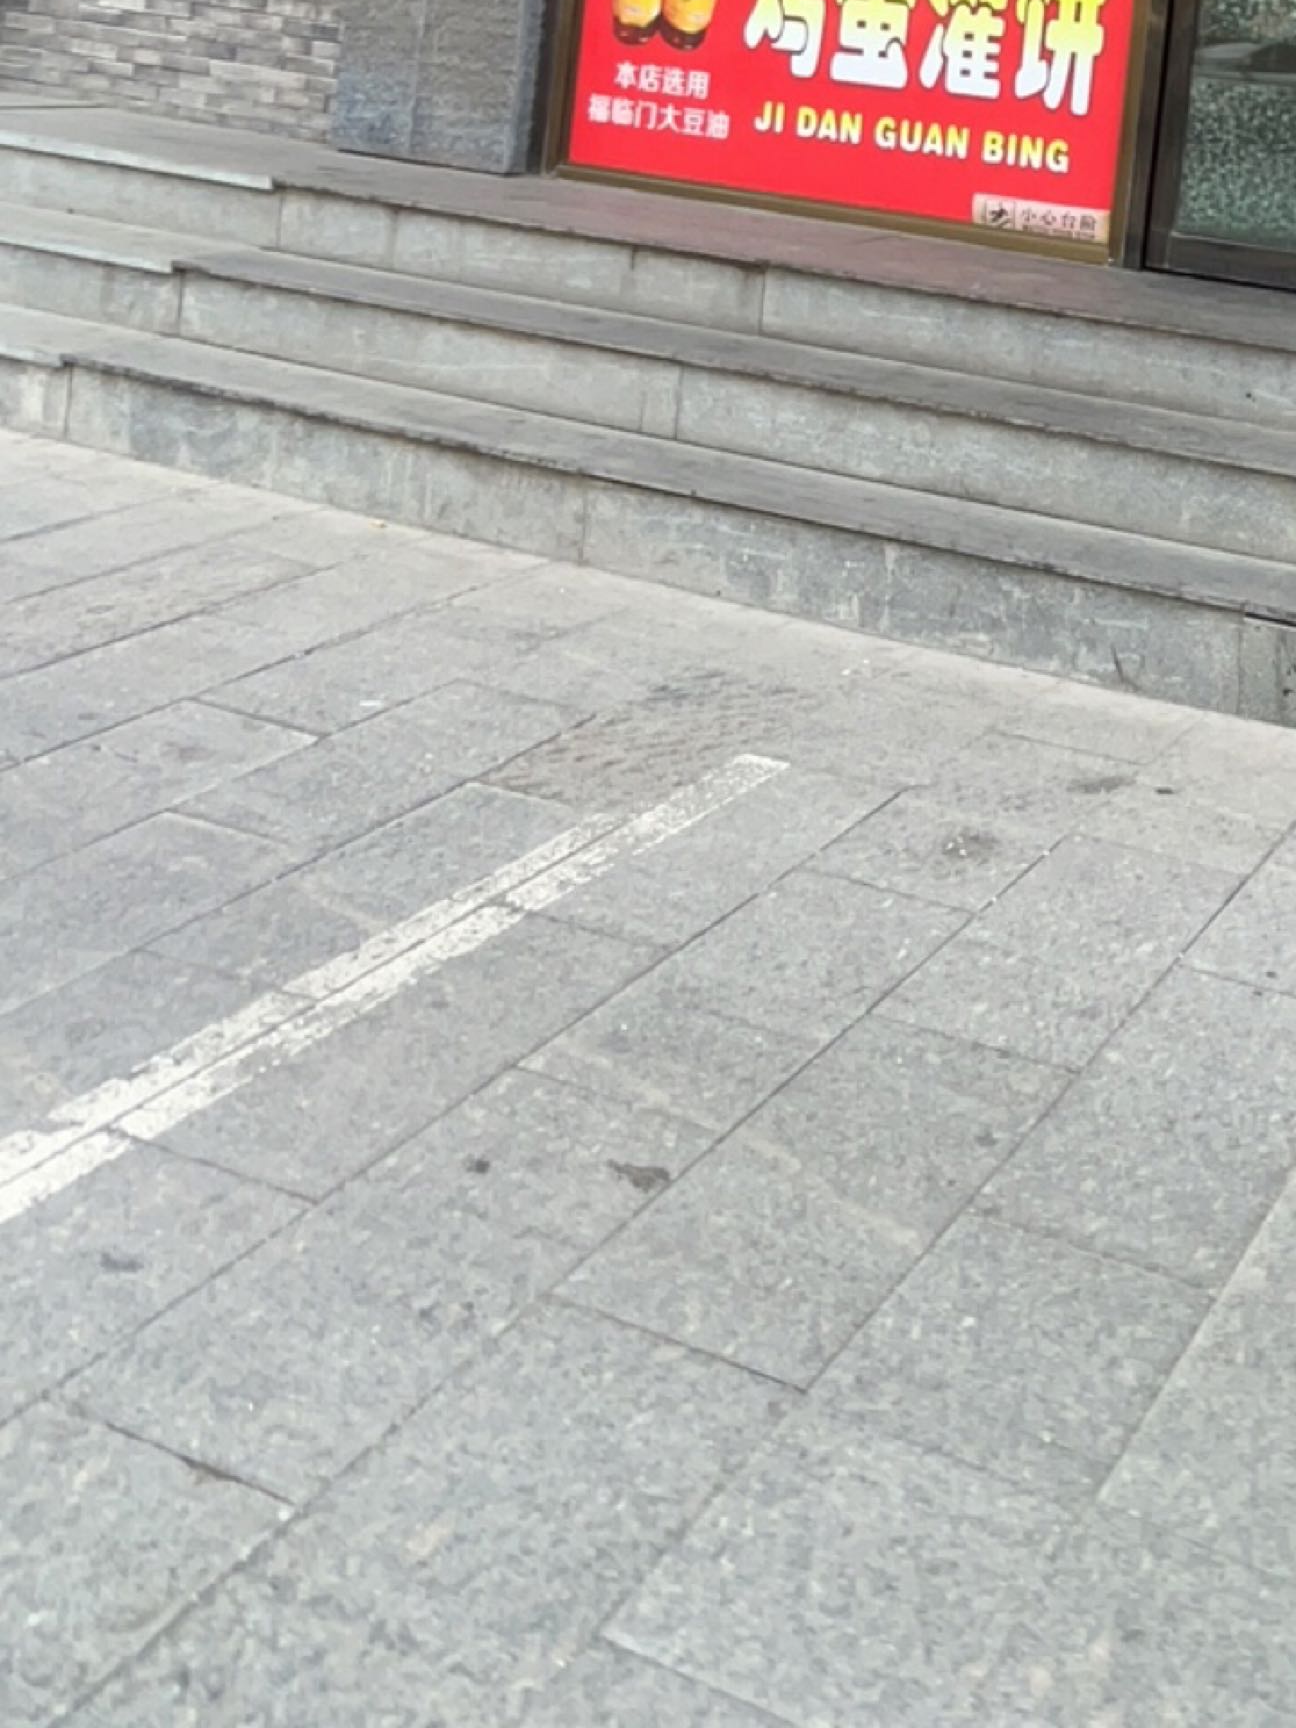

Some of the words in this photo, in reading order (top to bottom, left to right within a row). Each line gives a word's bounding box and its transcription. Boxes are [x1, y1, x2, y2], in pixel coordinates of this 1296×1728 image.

[614, 60, 711, 99] 本店选用
[753, 101, 785, 134] JI
[795, 108, 861, 145] DAN
[874, 117, 968, 160] GUAN
[982, 132, 1070, 173] BING
